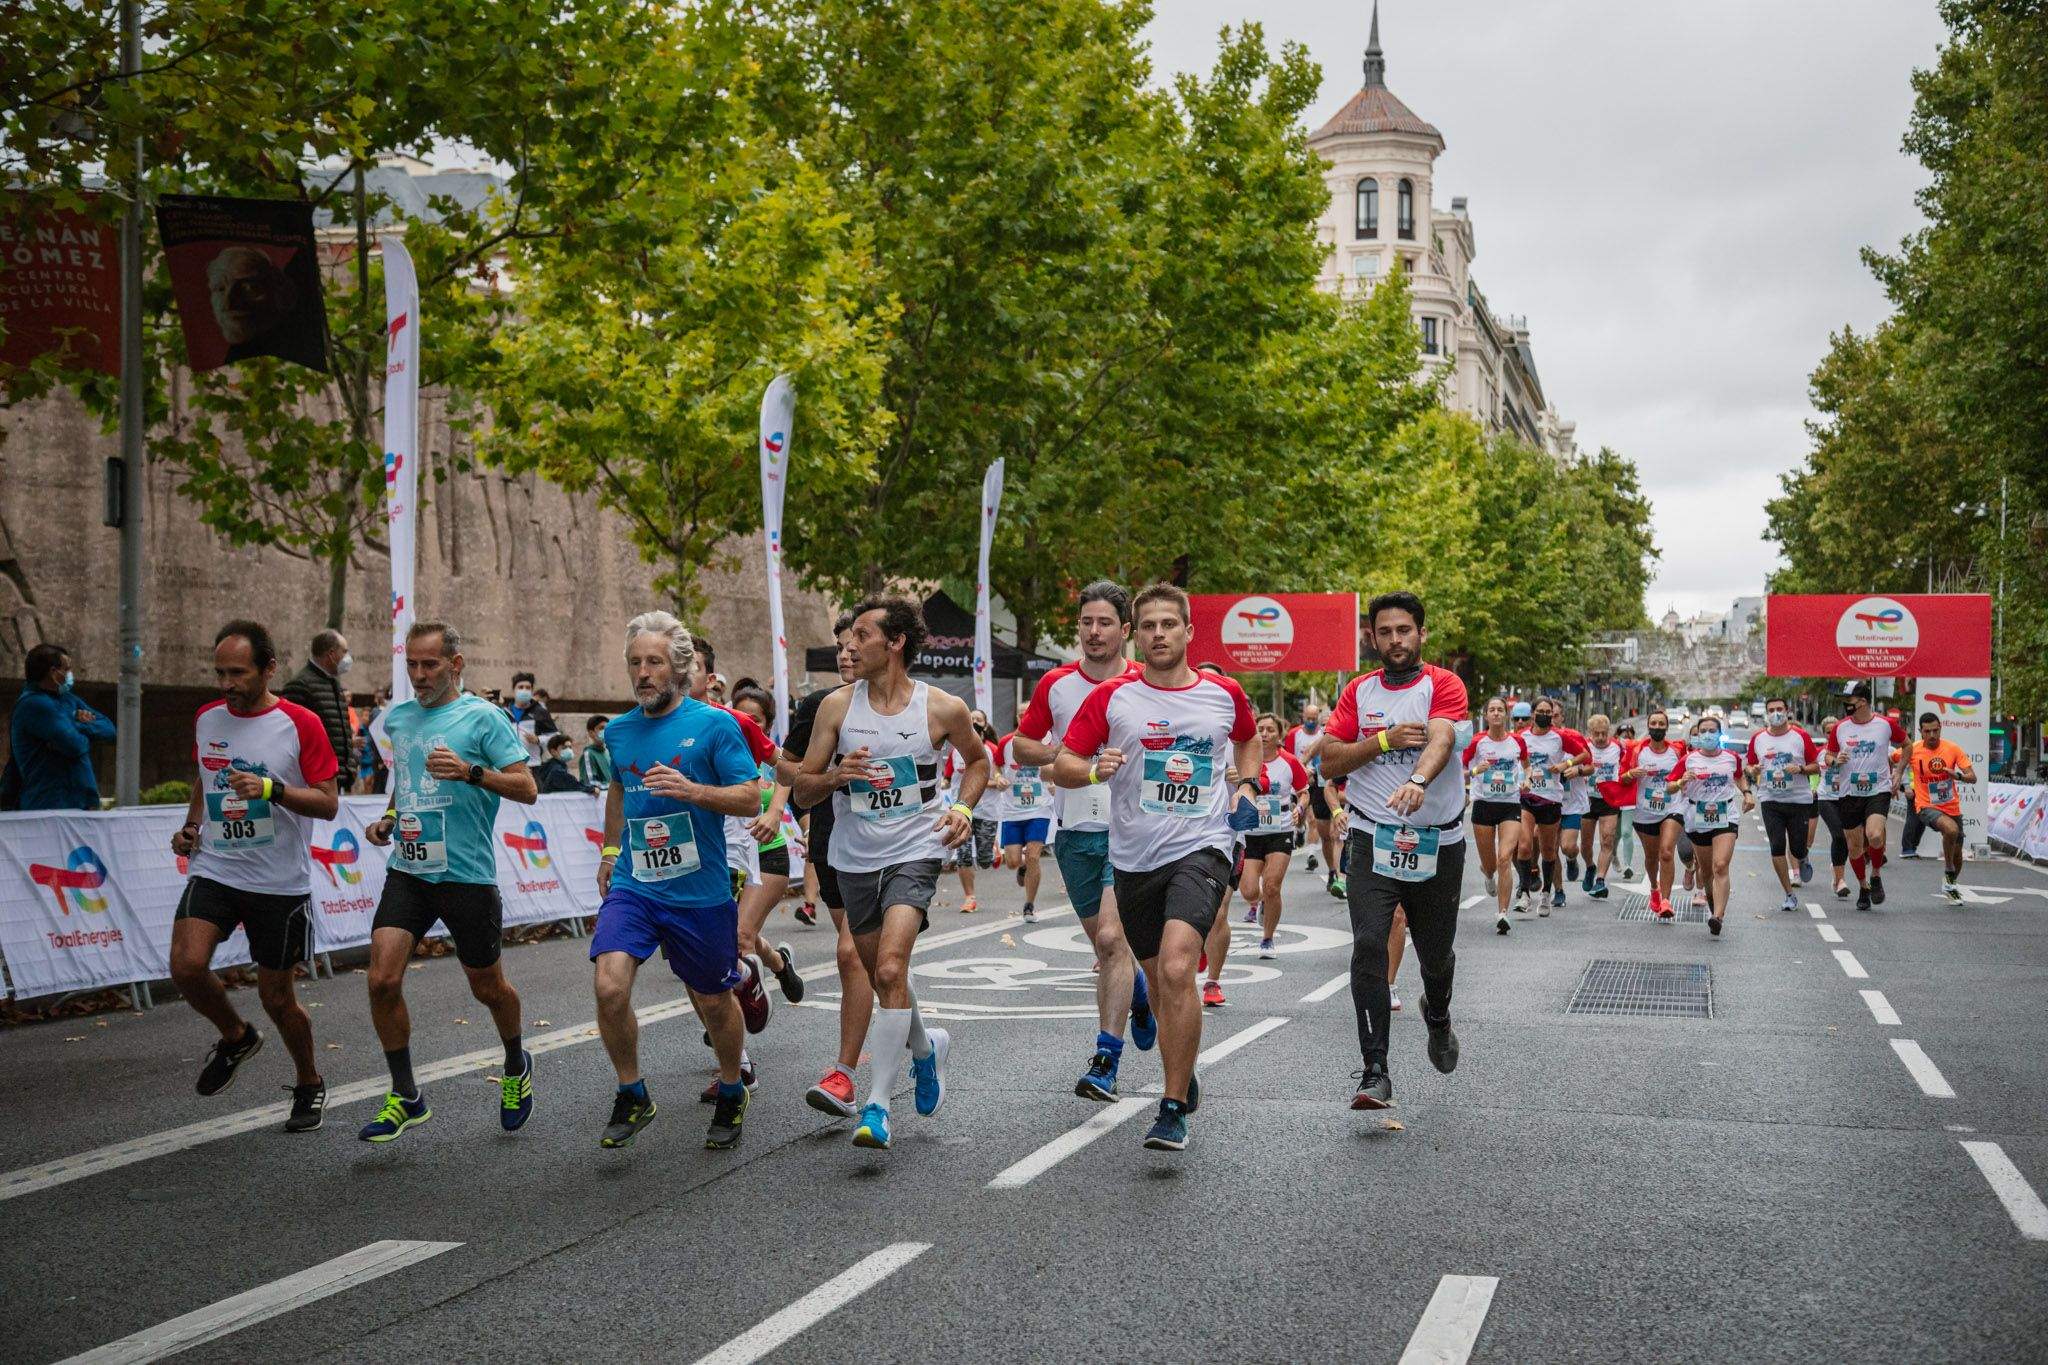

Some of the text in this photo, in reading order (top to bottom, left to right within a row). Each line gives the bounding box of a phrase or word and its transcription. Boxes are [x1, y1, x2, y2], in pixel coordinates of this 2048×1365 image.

[0, 243, 104, 269] ÓMEZ
[16, 270, 87, 282] CENTRO
[8, 284, 99, 298] CULTURAL
[31, 297, 53, 308] LA
[64, 296, 112, 312] VILLA
[1855, 634, 1903, 642] TotalEnergies
[868, 788, 903, 810] 262
[1157, 782, 1199, 805] 1029
[222, 820, 256, 840] 303
[400, 842, 428, 861] 395
[643, 846, 682, 869] 1128
[1389, 851, 1419, 870] 579
[320, 895, 375, 914] TotalEnergies
[47, 926, 124, 949] TotalEnergies
